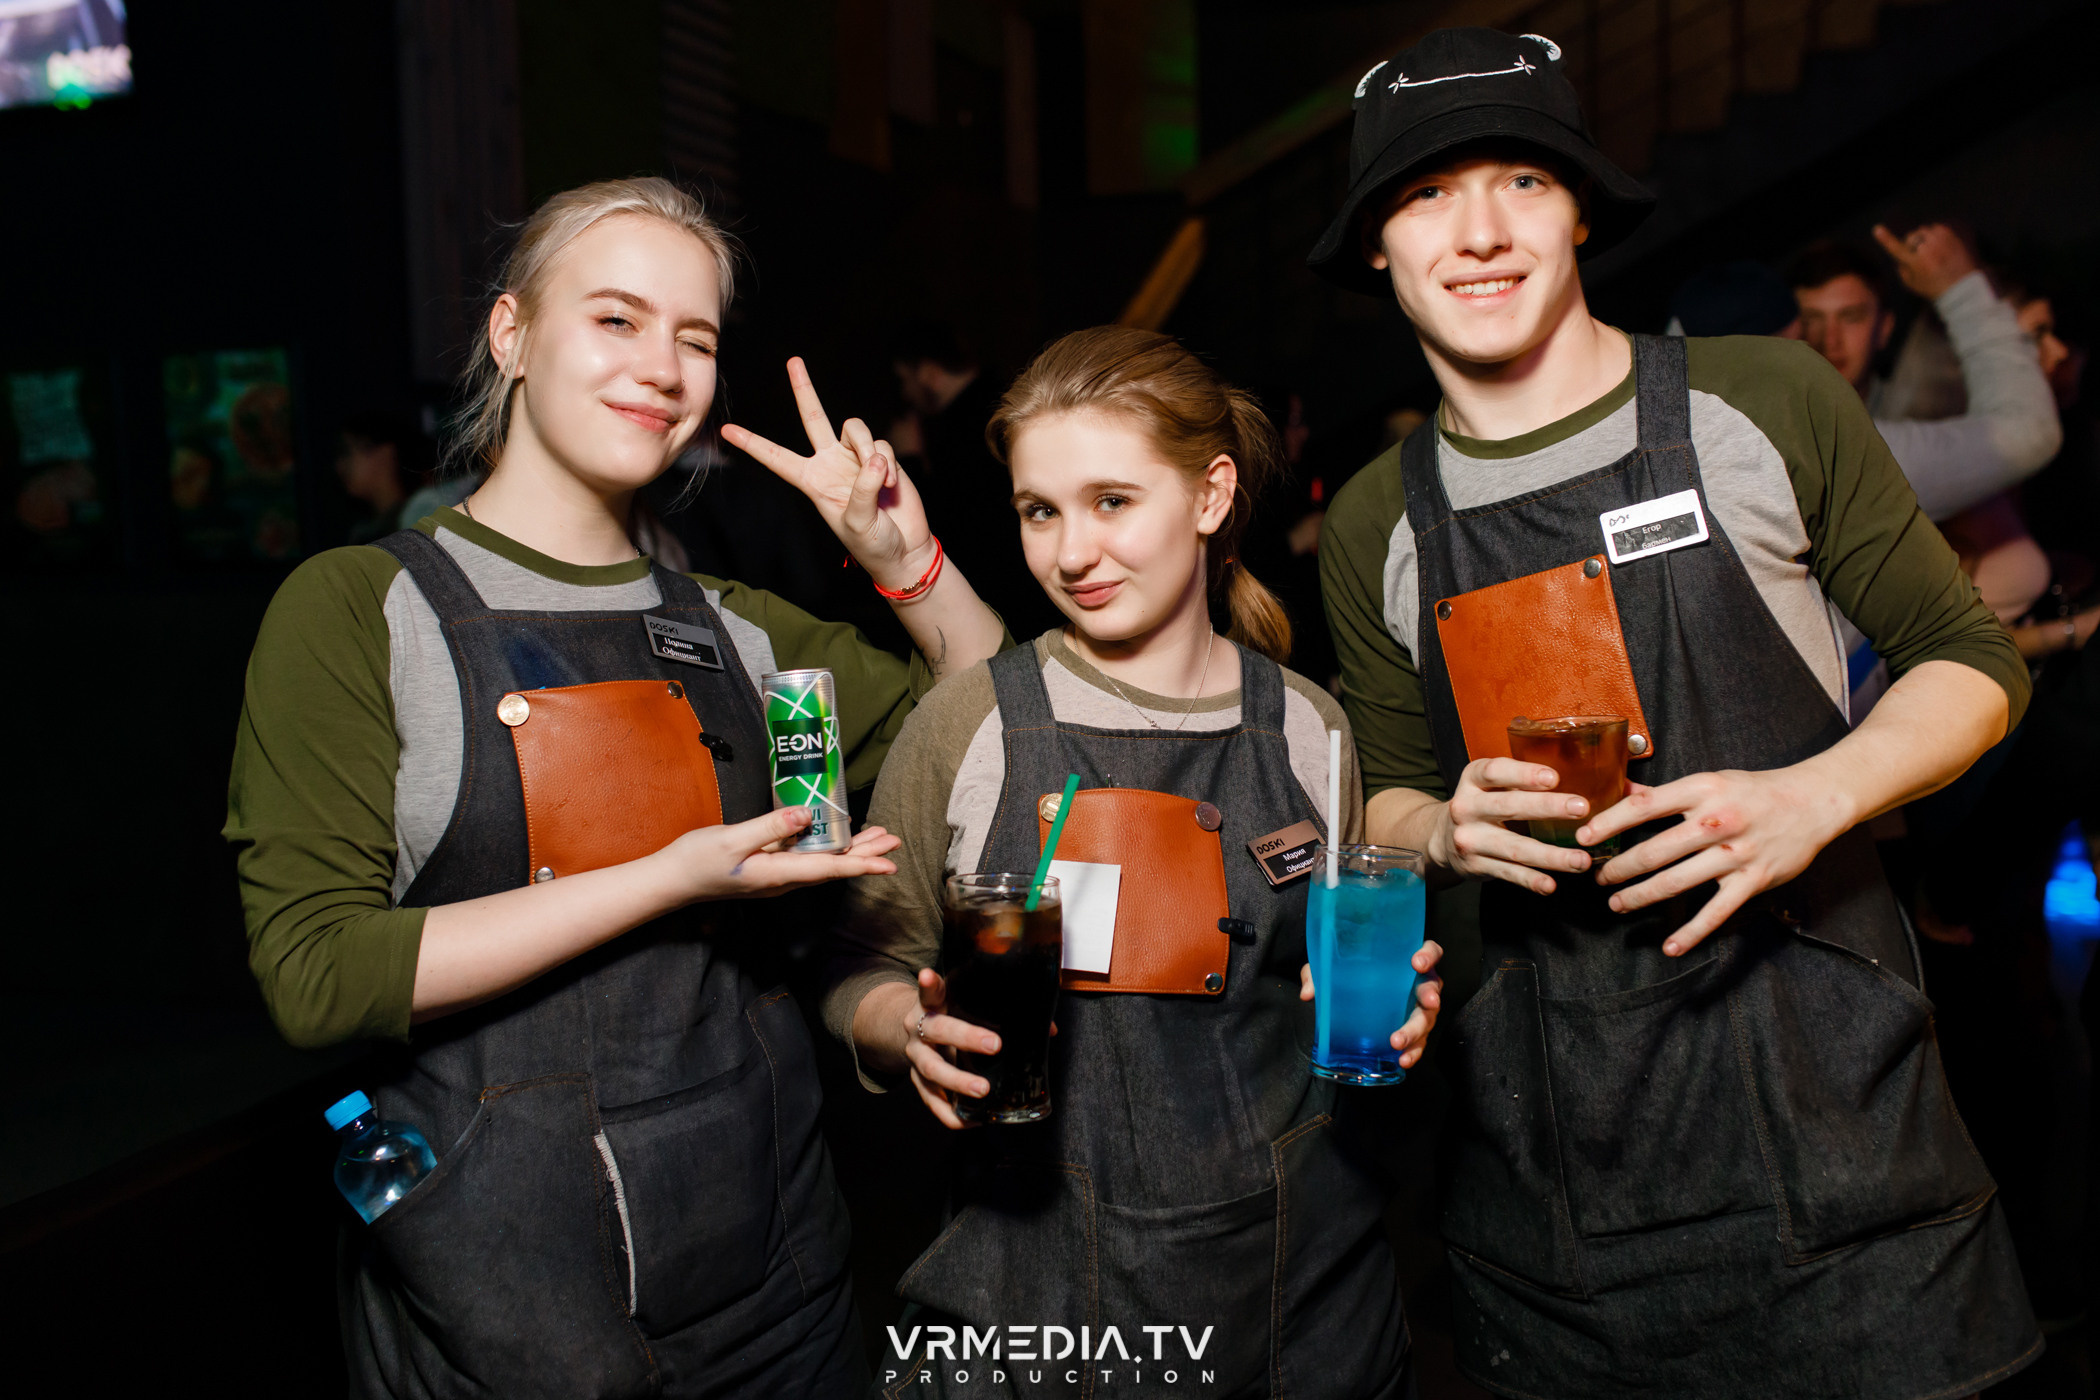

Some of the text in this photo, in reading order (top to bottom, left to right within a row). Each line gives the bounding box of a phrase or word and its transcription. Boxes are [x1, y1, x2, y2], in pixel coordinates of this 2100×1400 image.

[1642, 523, 1662, 534] Егор
[649, 622, 679, 635] DOSKI
[776, 732, 823, 752] EON
[779, 752, 823, 762] ENERGY DRINK
[1256, 838, 1286, 855] DOSKI
[1282, 848, 1307, 861] Мария
